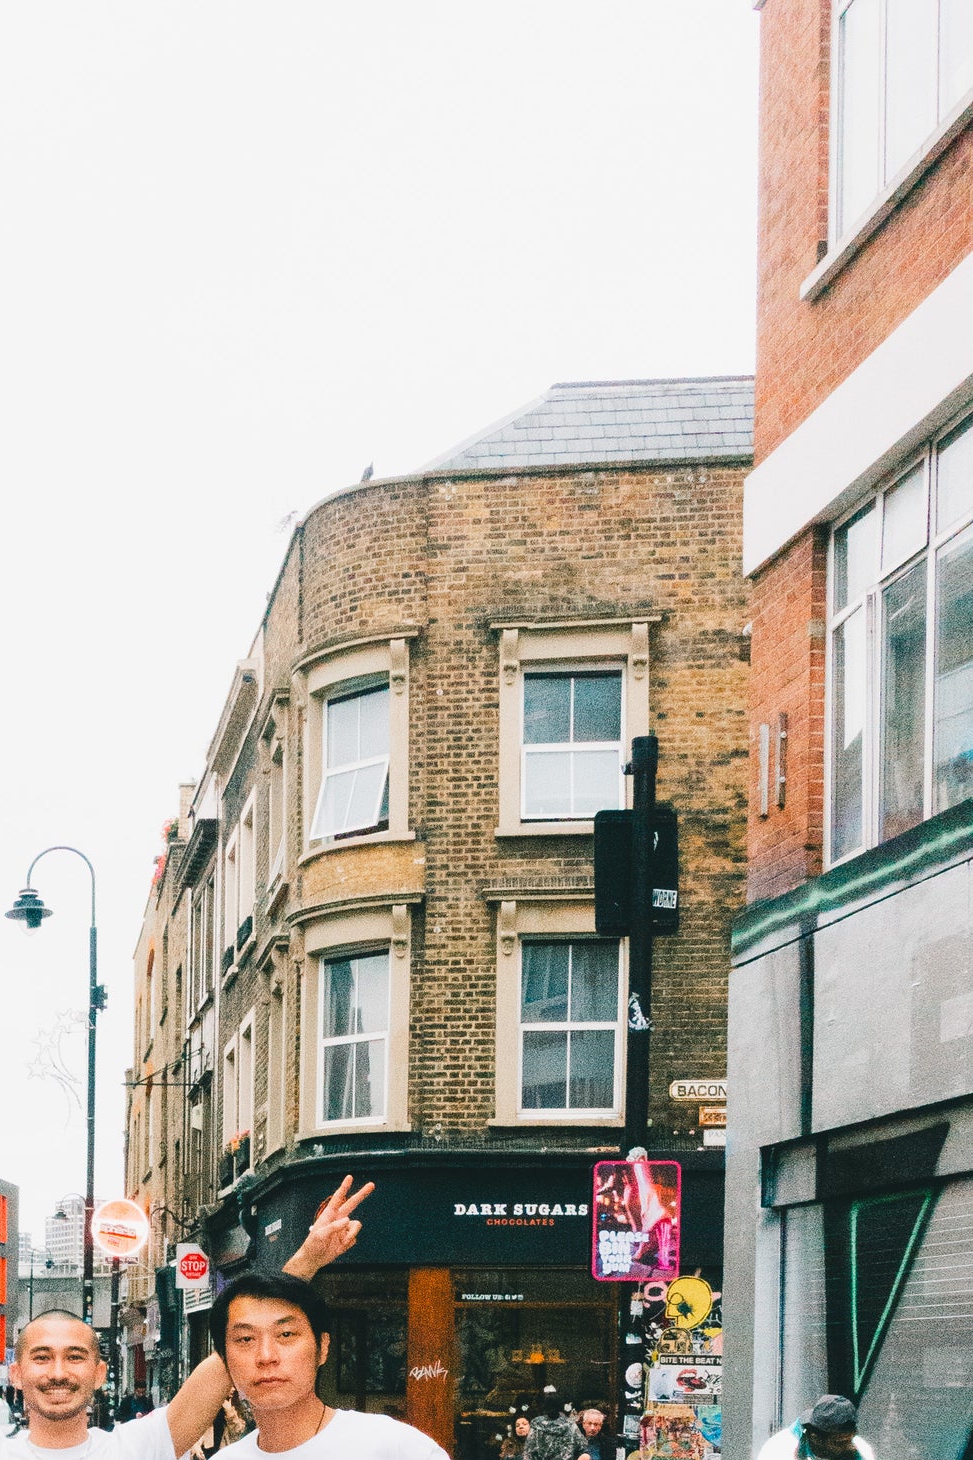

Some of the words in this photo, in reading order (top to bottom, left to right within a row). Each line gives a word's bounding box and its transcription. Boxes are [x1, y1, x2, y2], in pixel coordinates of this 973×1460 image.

[677, 1085, 727, 1097] BACON
[454, 1203, 507, 1216] DARK
[513, 1203, 588, 1216] SUGARS
[486, 1218, 555, 1226] CHOCOLATES
[599, 1230, 649, 1242] PLEASE
[181, 1260, 206, 1271] STOP
[660, 1356, 677, 1364] BITE
[678, 1356, 694, 1364] THE
[695, 1356, 714, 1365] BEAT
